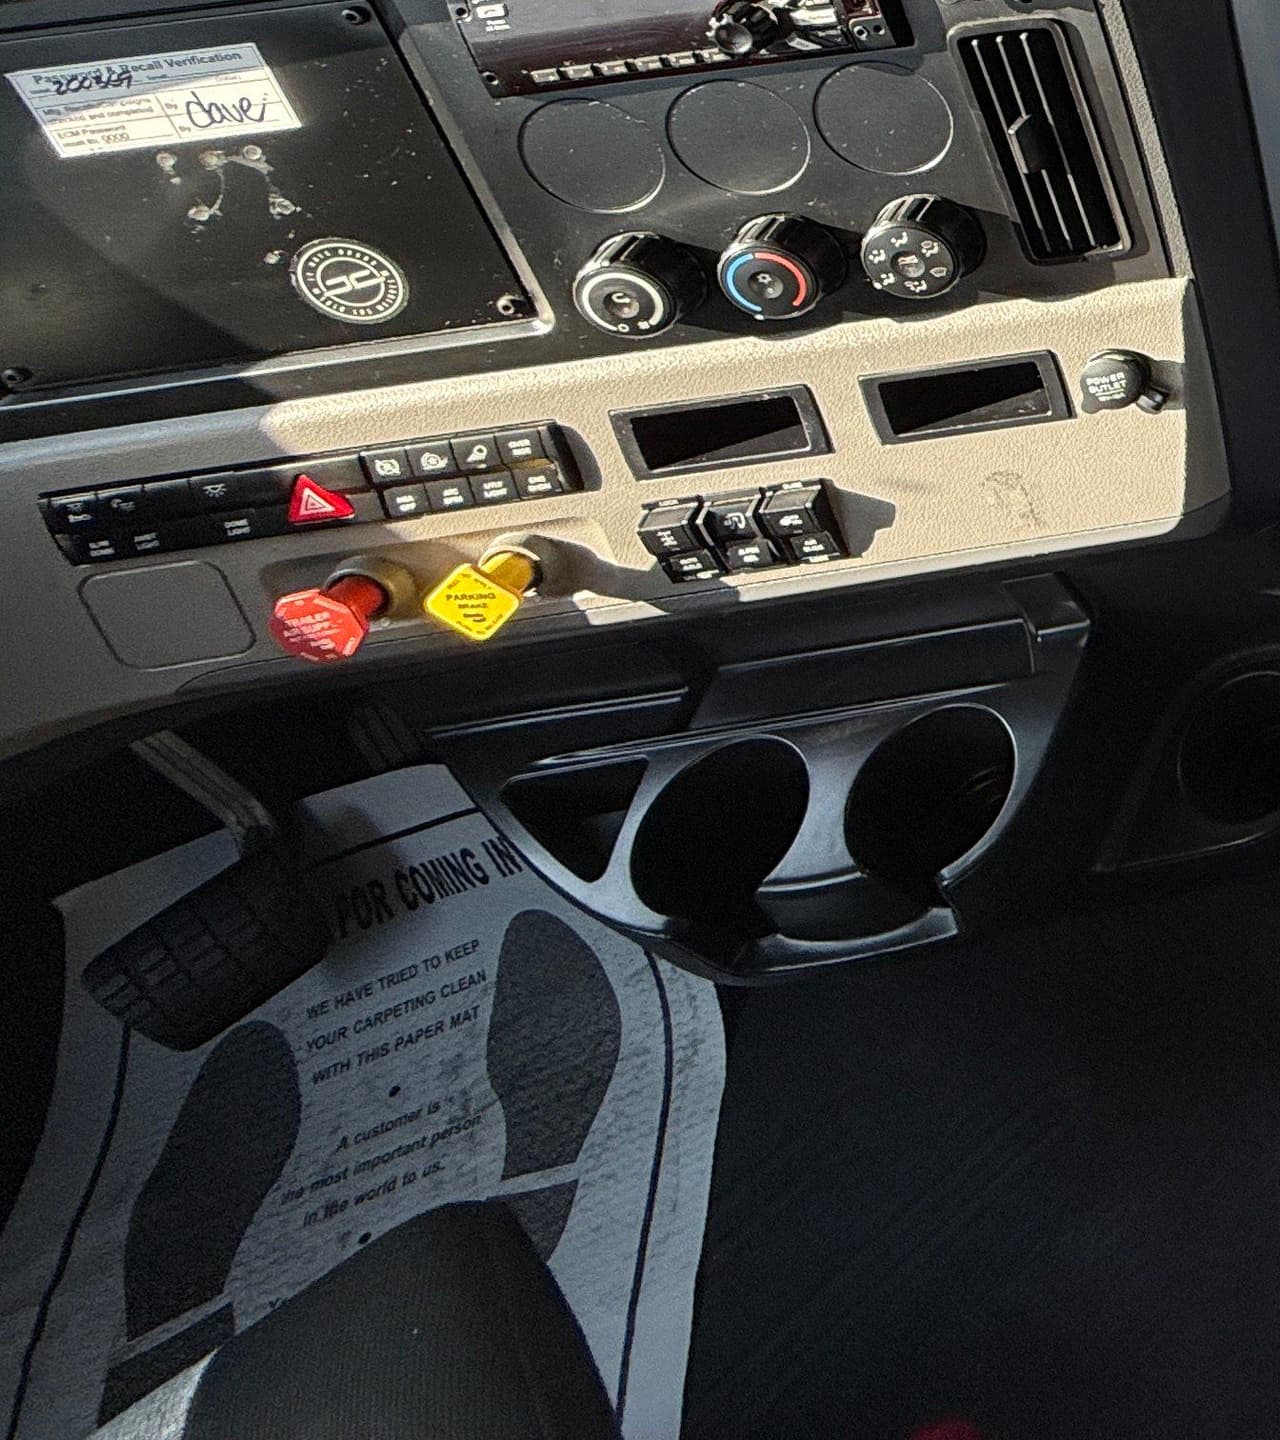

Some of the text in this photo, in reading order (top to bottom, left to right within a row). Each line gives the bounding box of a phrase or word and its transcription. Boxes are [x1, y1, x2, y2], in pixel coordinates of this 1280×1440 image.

[119, 60, 163, 75] Recall
[167, 50, 243, 69] Verification
[1086, 371, 1125, 386] POWER
[1088, 379, 1127, 394] OUTLET
[445, 591, 497, 601] PARKING
[332, 835, 524, 940] FOR COMING IN
[305, 939, 481, 1020] WE HAVE TRIED TO KEEP
[305, 969, 488, 1053] YOUR CARPETING CLEAN
[311, 1004, 482, 1085] WITH THIS PAPER MAT
[309, 1167, 349, 1192] most
[352, 1135, 428, 1177] important
[428, 1114, 483, 1150] person
[335, 1100, 442, 1153] A customer is
[303, 1209, 319, 1227] in
[322, 1198, 350, 1220] the
[354, 1176, 398, 1206] world
[401, 1170, 417, 1187] to
